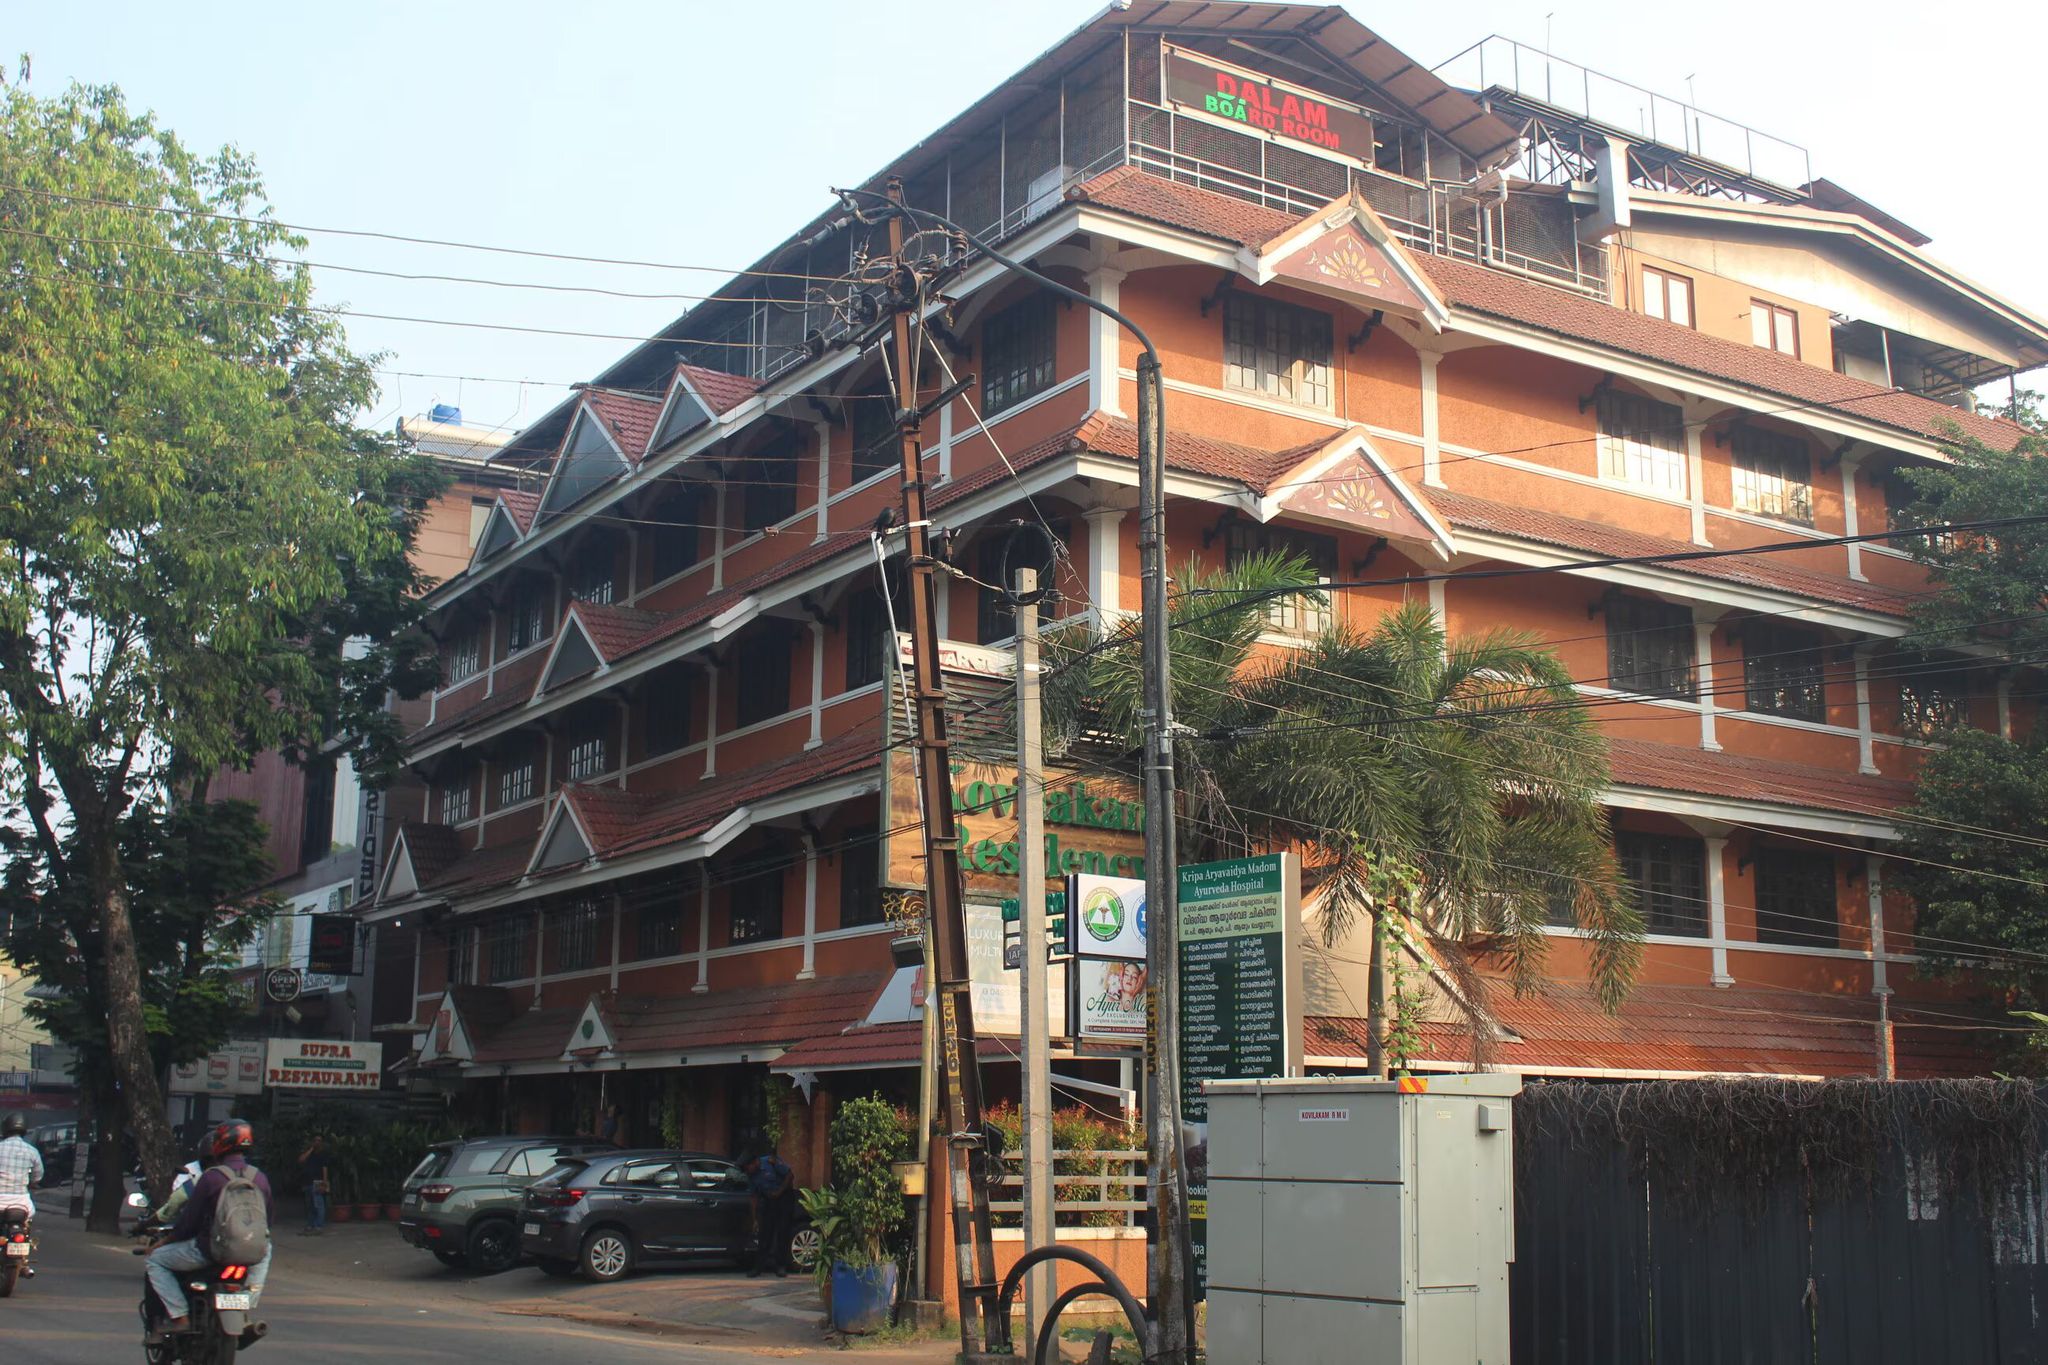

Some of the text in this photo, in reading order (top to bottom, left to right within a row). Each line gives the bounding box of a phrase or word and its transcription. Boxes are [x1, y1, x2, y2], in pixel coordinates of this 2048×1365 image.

[1216, 72, 1328, 129] DALAM
[1205, 95, 1340, 149] BOARD ROOM
[1182, 862, 1276, 884] Kripa Aryavaidya Madom
[1194, 878, 1264, 898] Ayurveda Hospital
[968, 928, 1003, 941] LUXUR
[271, 976, 296, 984] OPEN
[1087, 992, 1146, 1018] Ayur Mo
[300, 1043, 352, 1058] SUPRA
[269, 1069, 379, 1086] RESTAURANT
[1302, 1111, 1330, 1119] KOVILAKAM
